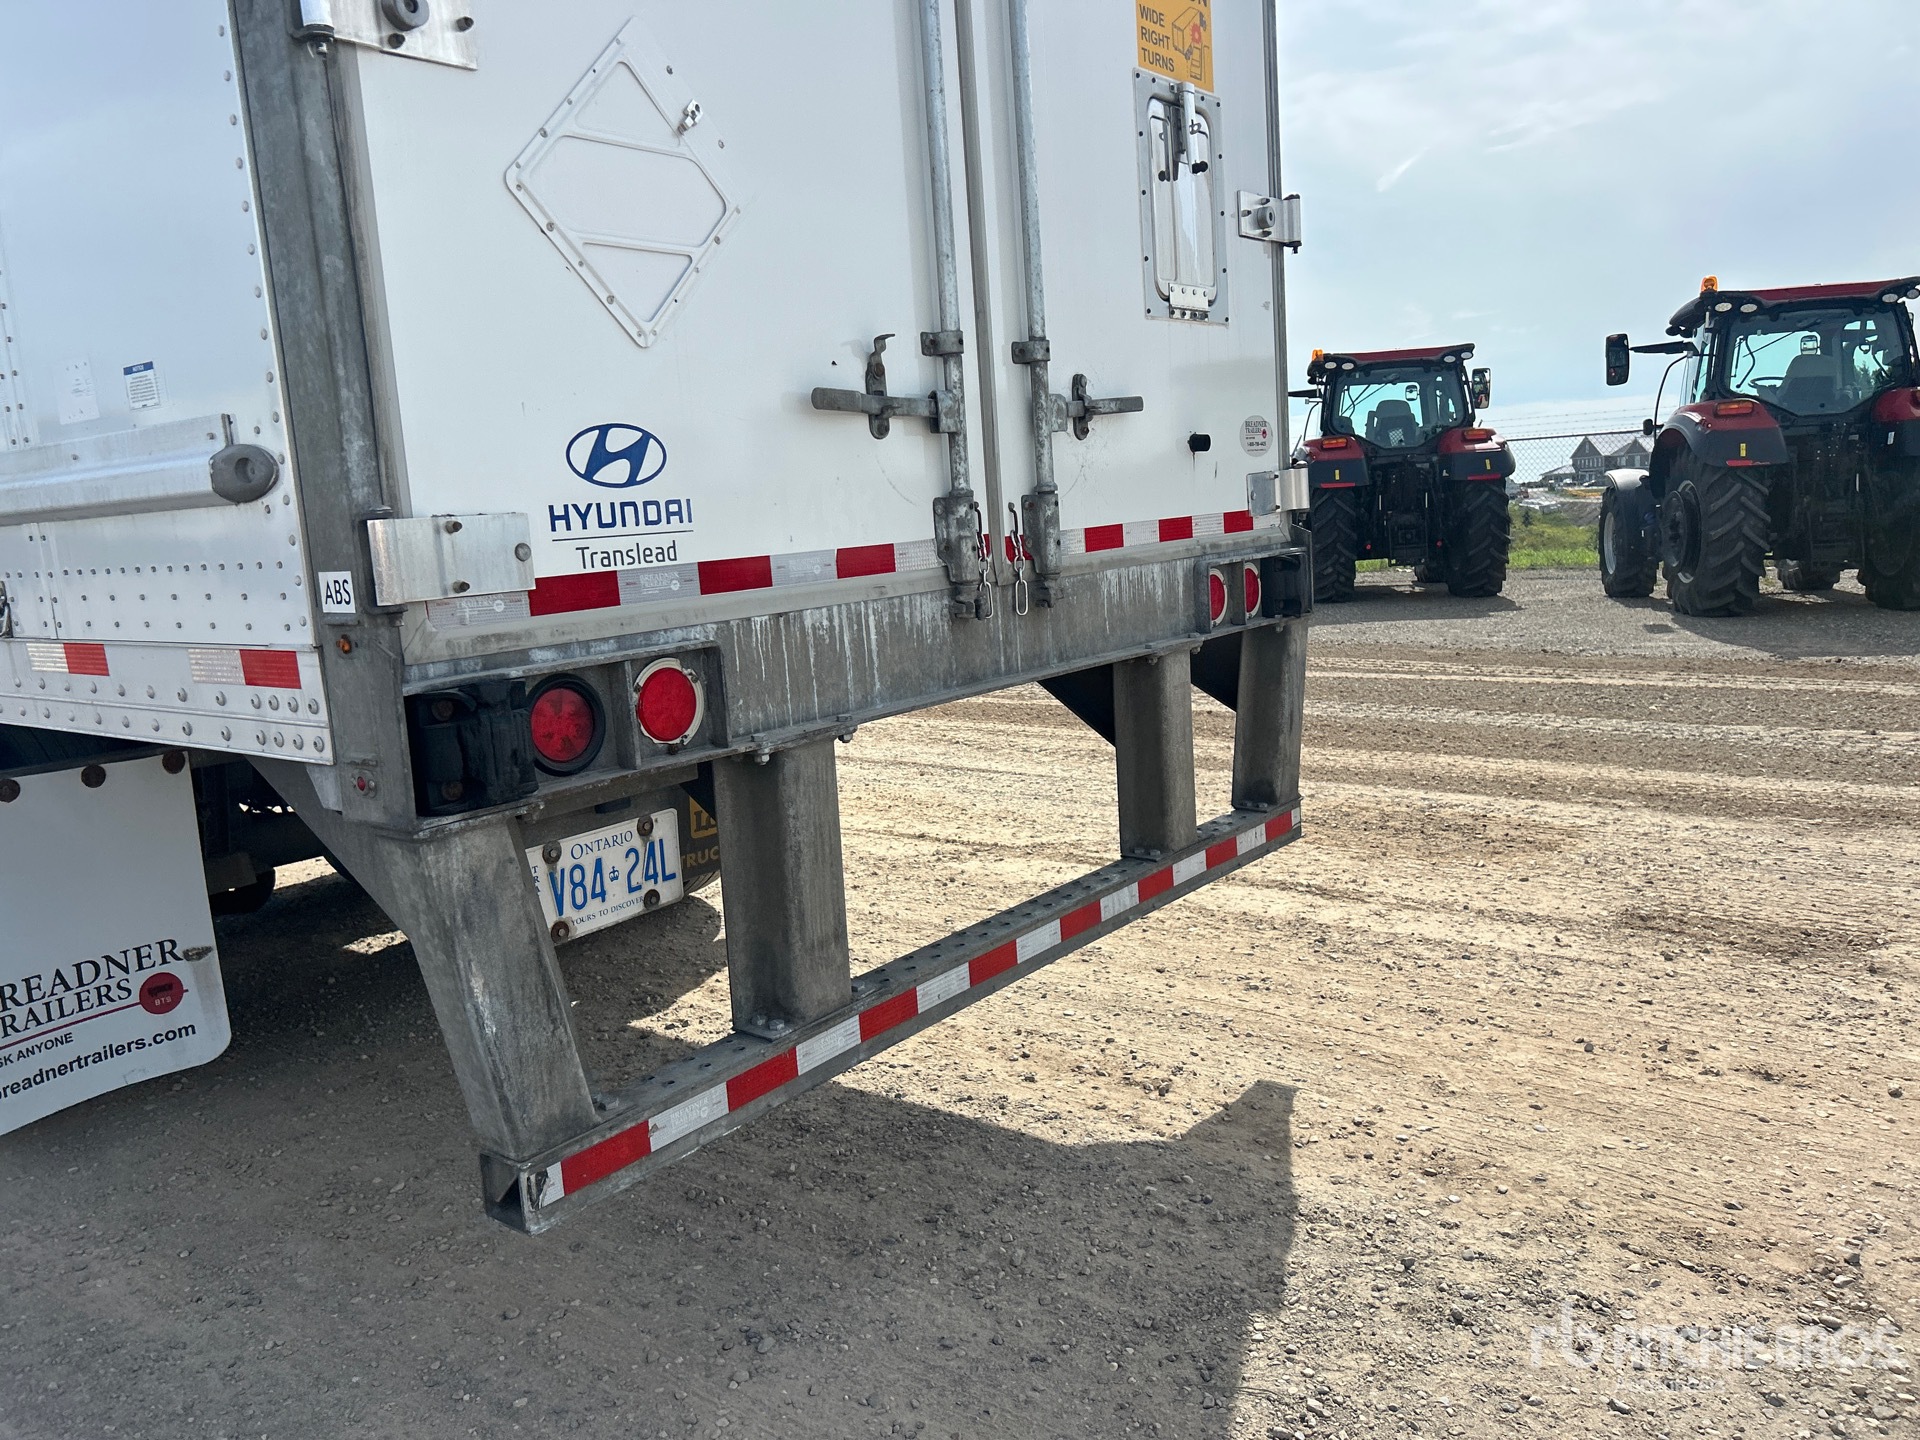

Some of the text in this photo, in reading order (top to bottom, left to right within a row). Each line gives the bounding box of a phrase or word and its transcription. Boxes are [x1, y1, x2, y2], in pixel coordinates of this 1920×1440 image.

[1139, 4, 1165, 28] WIDE
[1140, 26, 1170, 50] RIGHT
[1141, 47, 1175, 72] TURNS
[548, 498, 693, 532] HYUNDAI
[575, 540, 678, 569] Translead
[325, 579, 351, 605] ABS
[570, 830, 633, 860] ONTARIO
[549, 838, 677, 917] V84 24L
[571, 913, 596, 926] YOURS
[599, 908, 609, 917] TO
[0, 1023, 197, 1099] readnertrailers.com
[17, 1032, 74, 1061] ANYONE
